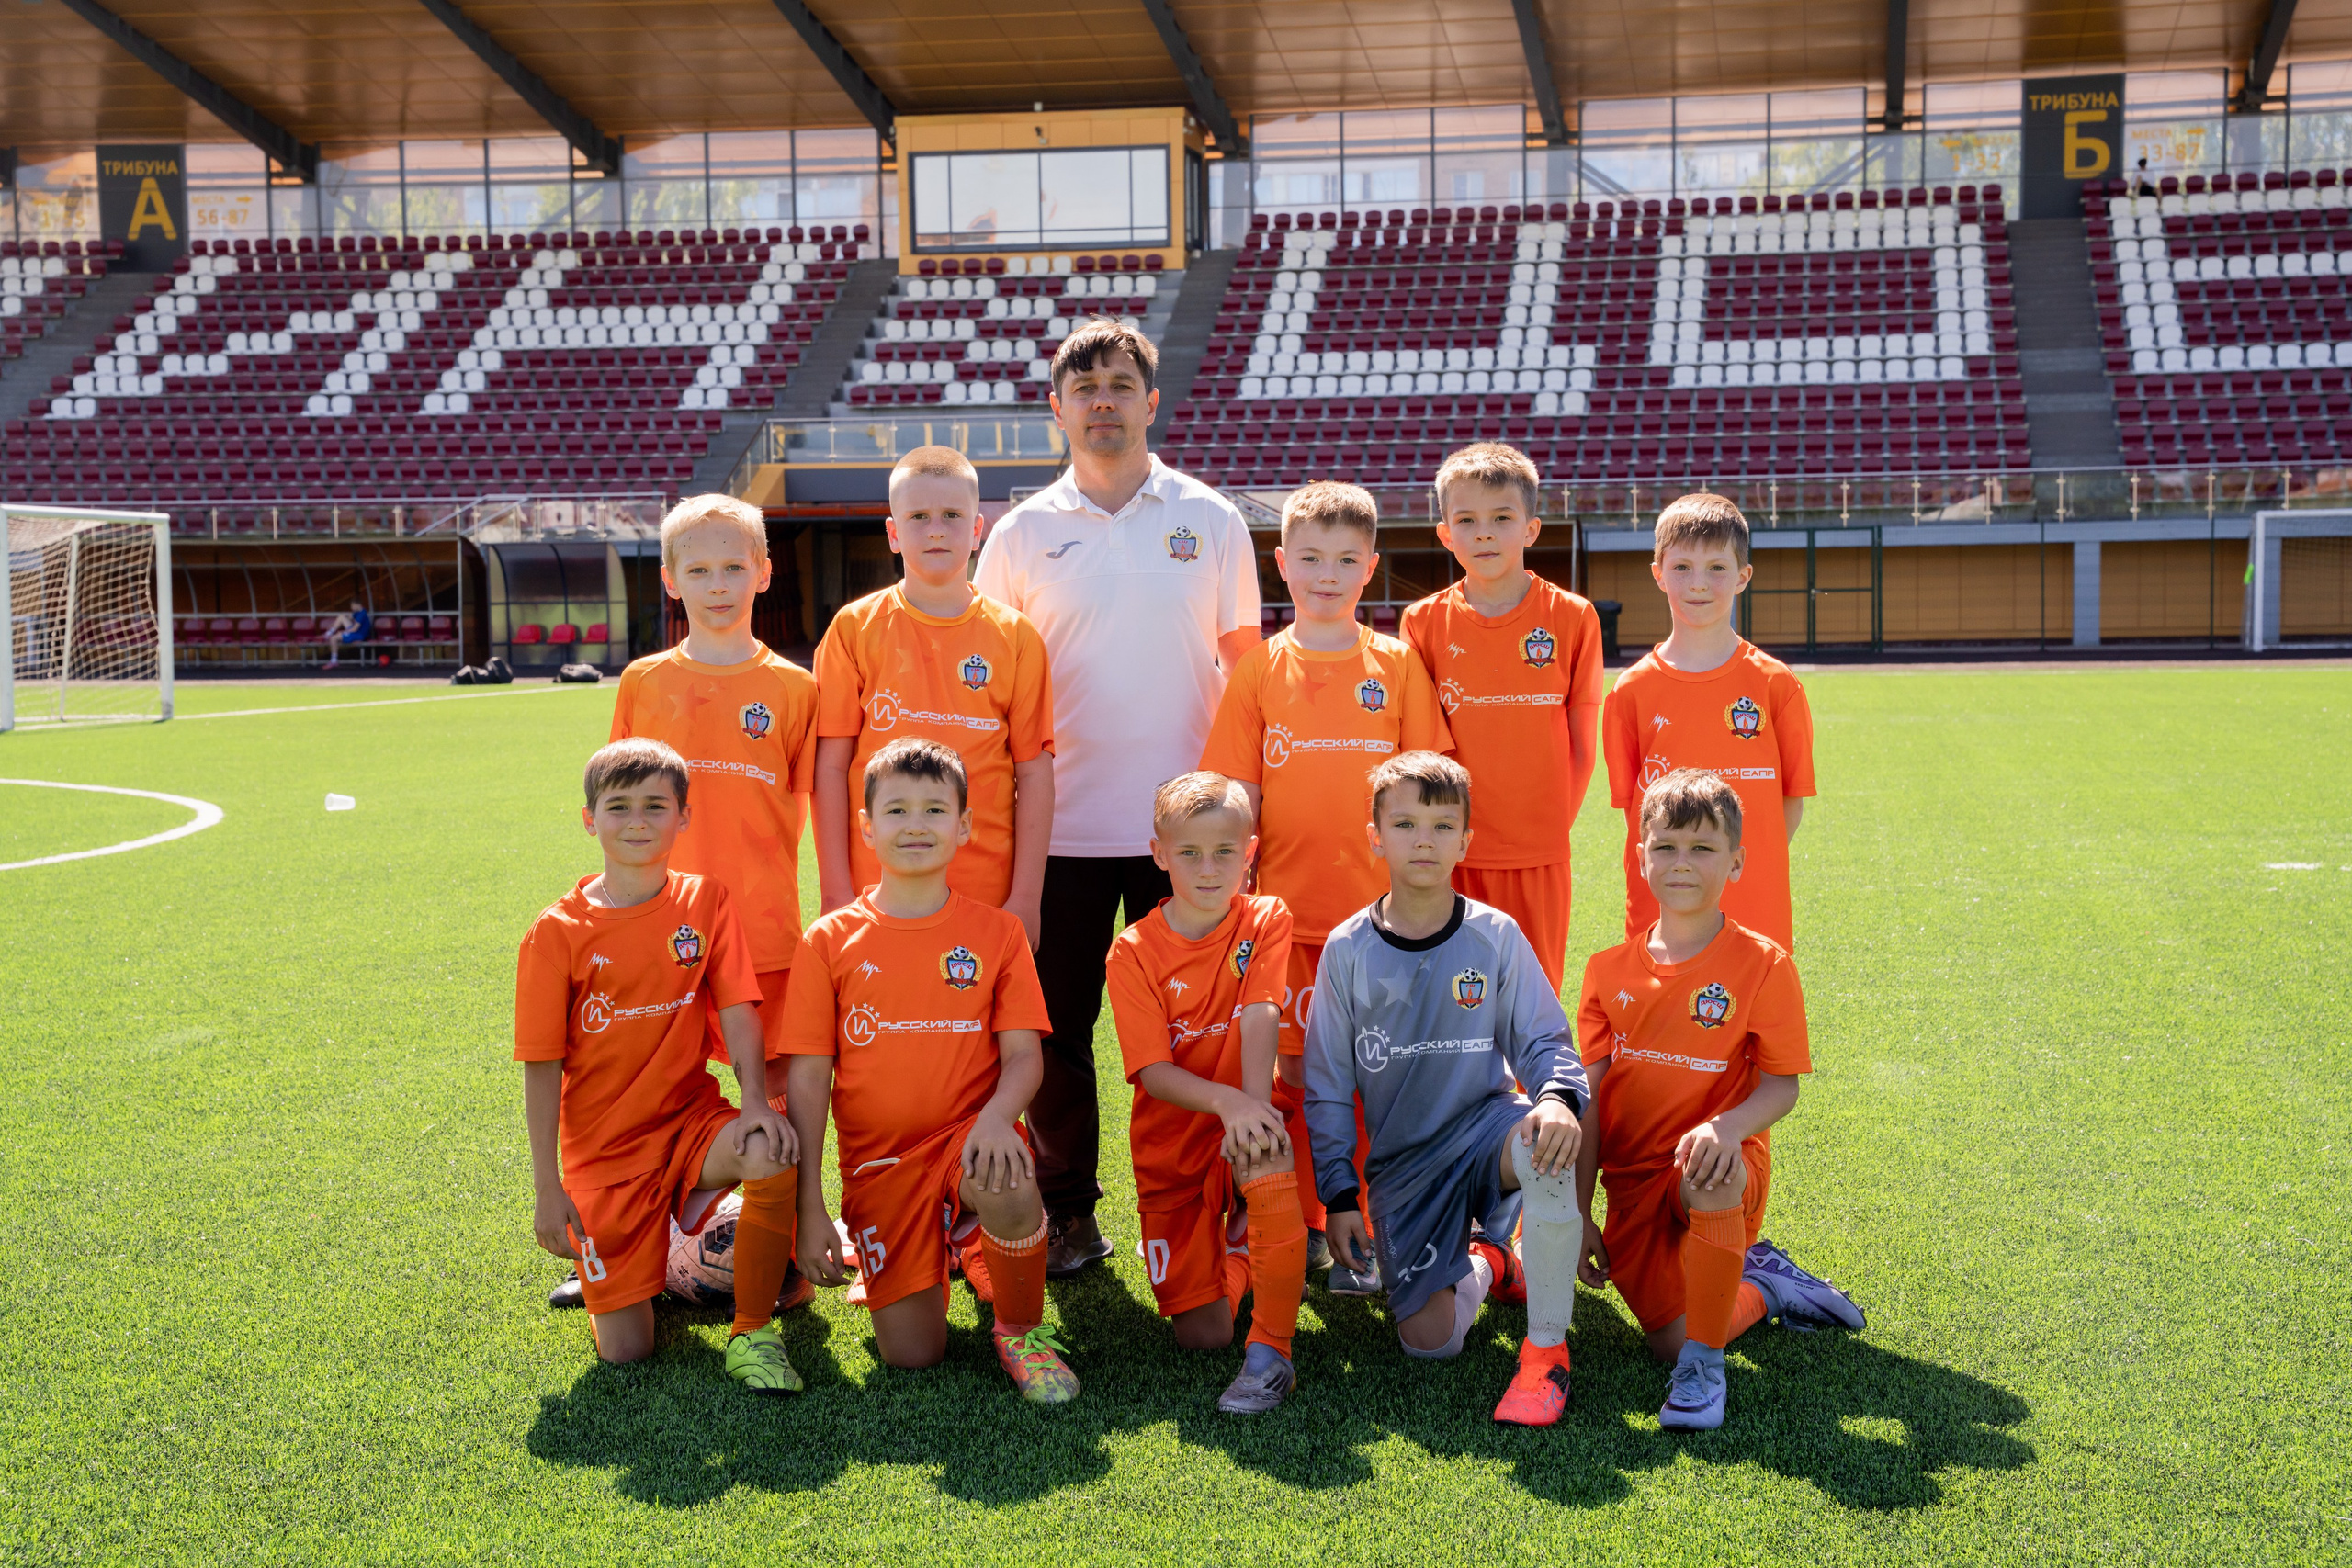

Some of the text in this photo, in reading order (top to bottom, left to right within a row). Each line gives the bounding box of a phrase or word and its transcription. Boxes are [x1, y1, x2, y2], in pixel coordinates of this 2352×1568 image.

[2029, 91, 2120, 111] ТРИБУНА
[2064, 109, 2110, 179] Б
[101, 160, 178, 176] ТРИБУНА
[127, 177, 178, 241] А
[197, 209, 249, 226] 56-87
[1529, 642, 1550, 650] ДЮСШ
[1463, 694, 1531, 704] РУССКИЙ
[899, 708, 1000, 729] РУССКИЙ САПР
[1291, 738, 1393, 751] РУССКИЙ САПР
[685, 759, 745, 772] УССКИЙ
[1741, 769, 1775, 778] САПР
[678, 940, 697, 951] ДЮСШ
[950, 961, 973, 970] ДЮСШ
[614, 998, 684, 1017] РУССКИЙ
[1700, 998, 1724, 1010] ДЮСШ
[878, 1020, 952, 1030] РУССКИЙ
[1183, 1021, 1230, 1038] РУССК
[1621, 1047, 1727, 1071] РУССКИЙ САПР
[581, 1236, 607, 1283] 8
[855, 1225, 887, 1278] 15
